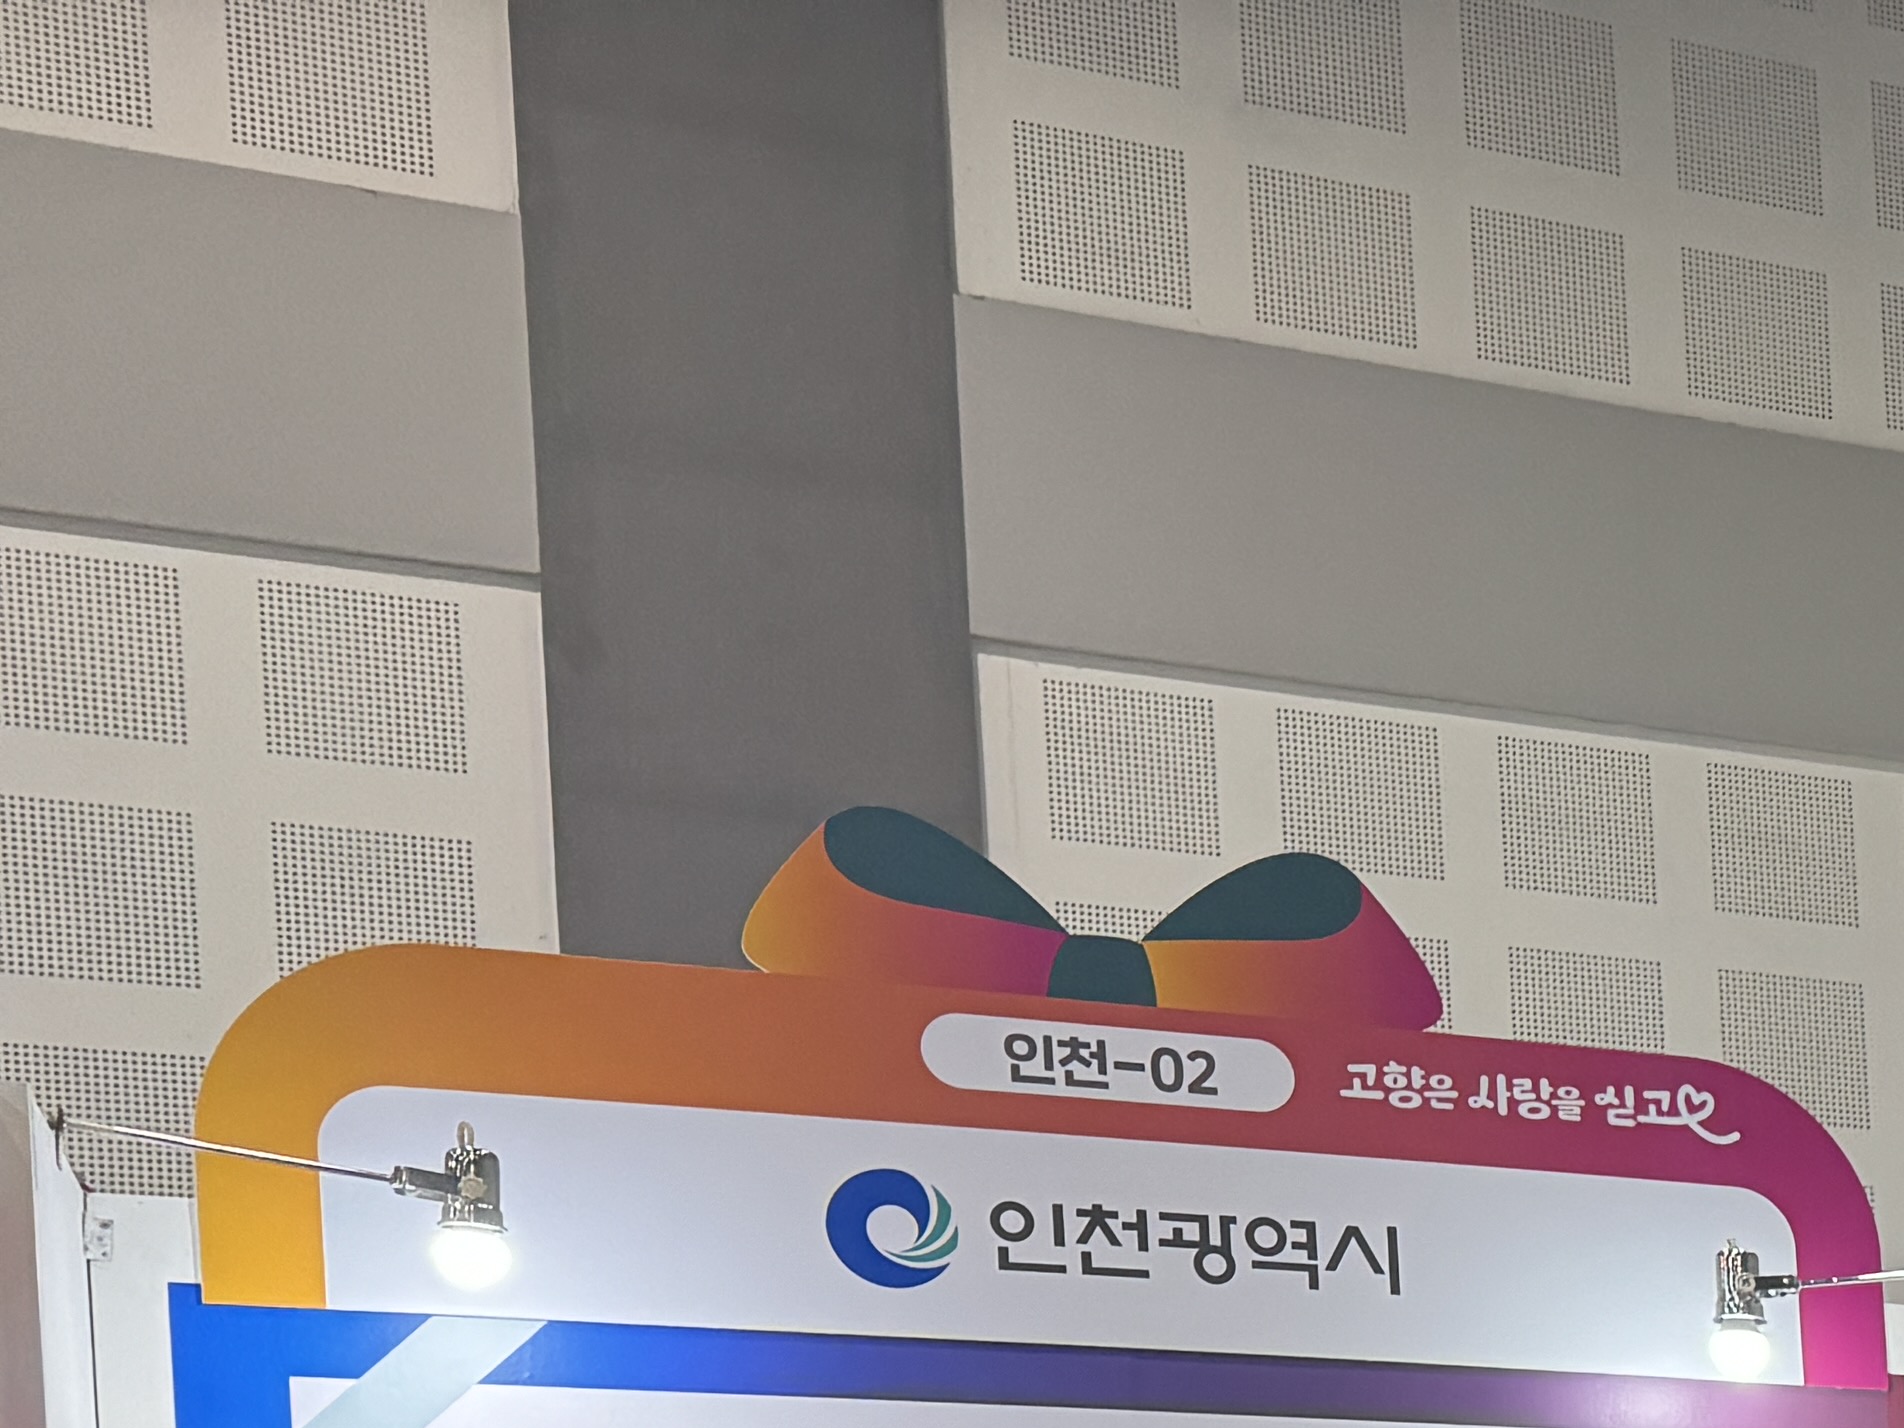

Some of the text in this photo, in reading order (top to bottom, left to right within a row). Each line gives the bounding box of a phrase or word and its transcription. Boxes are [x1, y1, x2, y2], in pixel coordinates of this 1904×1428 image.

[1004, 1033, 1218, 1095] 인천-02
[1339, 1063, 1457, 1110] 고향은
[1467, 1074, 1585, 1123] 사랑을
[989, 1200, 1401, 1297] 인천광역시
